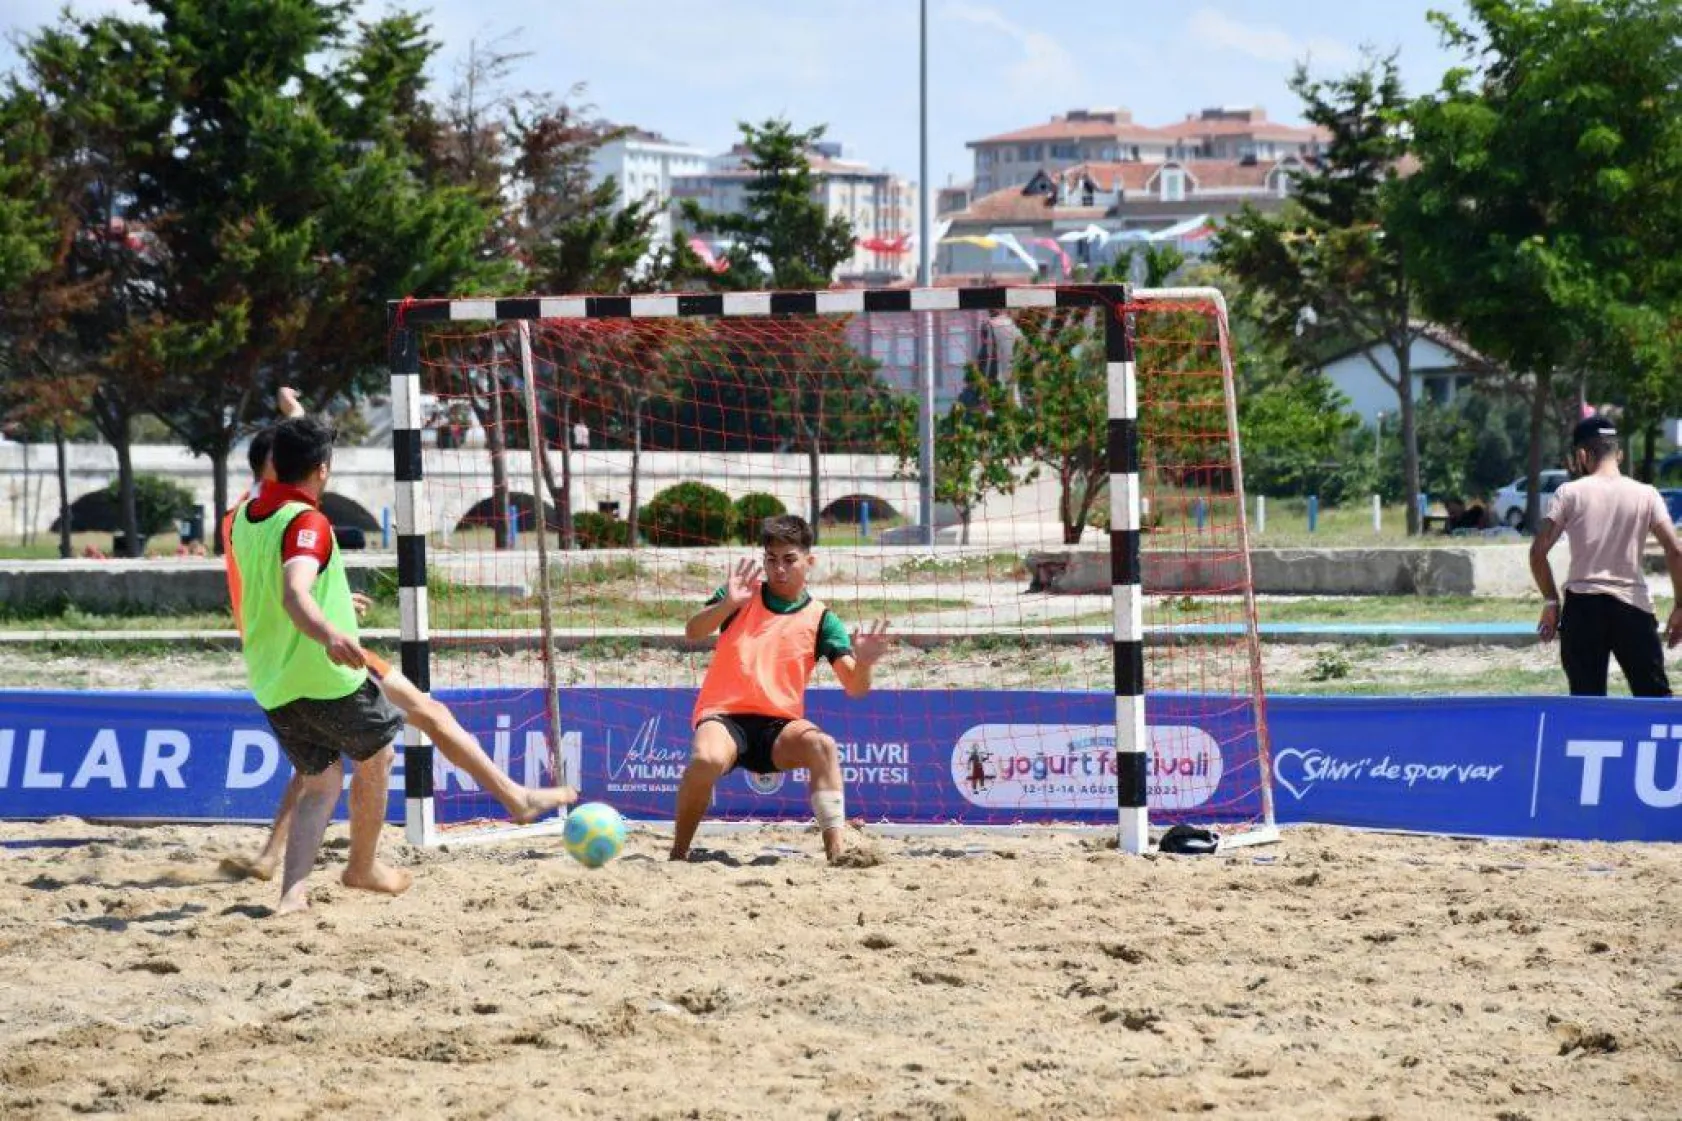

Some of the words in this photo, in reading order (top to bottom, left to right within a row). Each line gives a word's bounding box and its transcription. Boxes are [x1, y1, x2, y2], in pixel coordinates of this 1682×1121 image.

[628, 765, 687, 779] YILMAZ
[1402, 763, 1457, 789] spor
[1458, 763, 1504, 783] var
